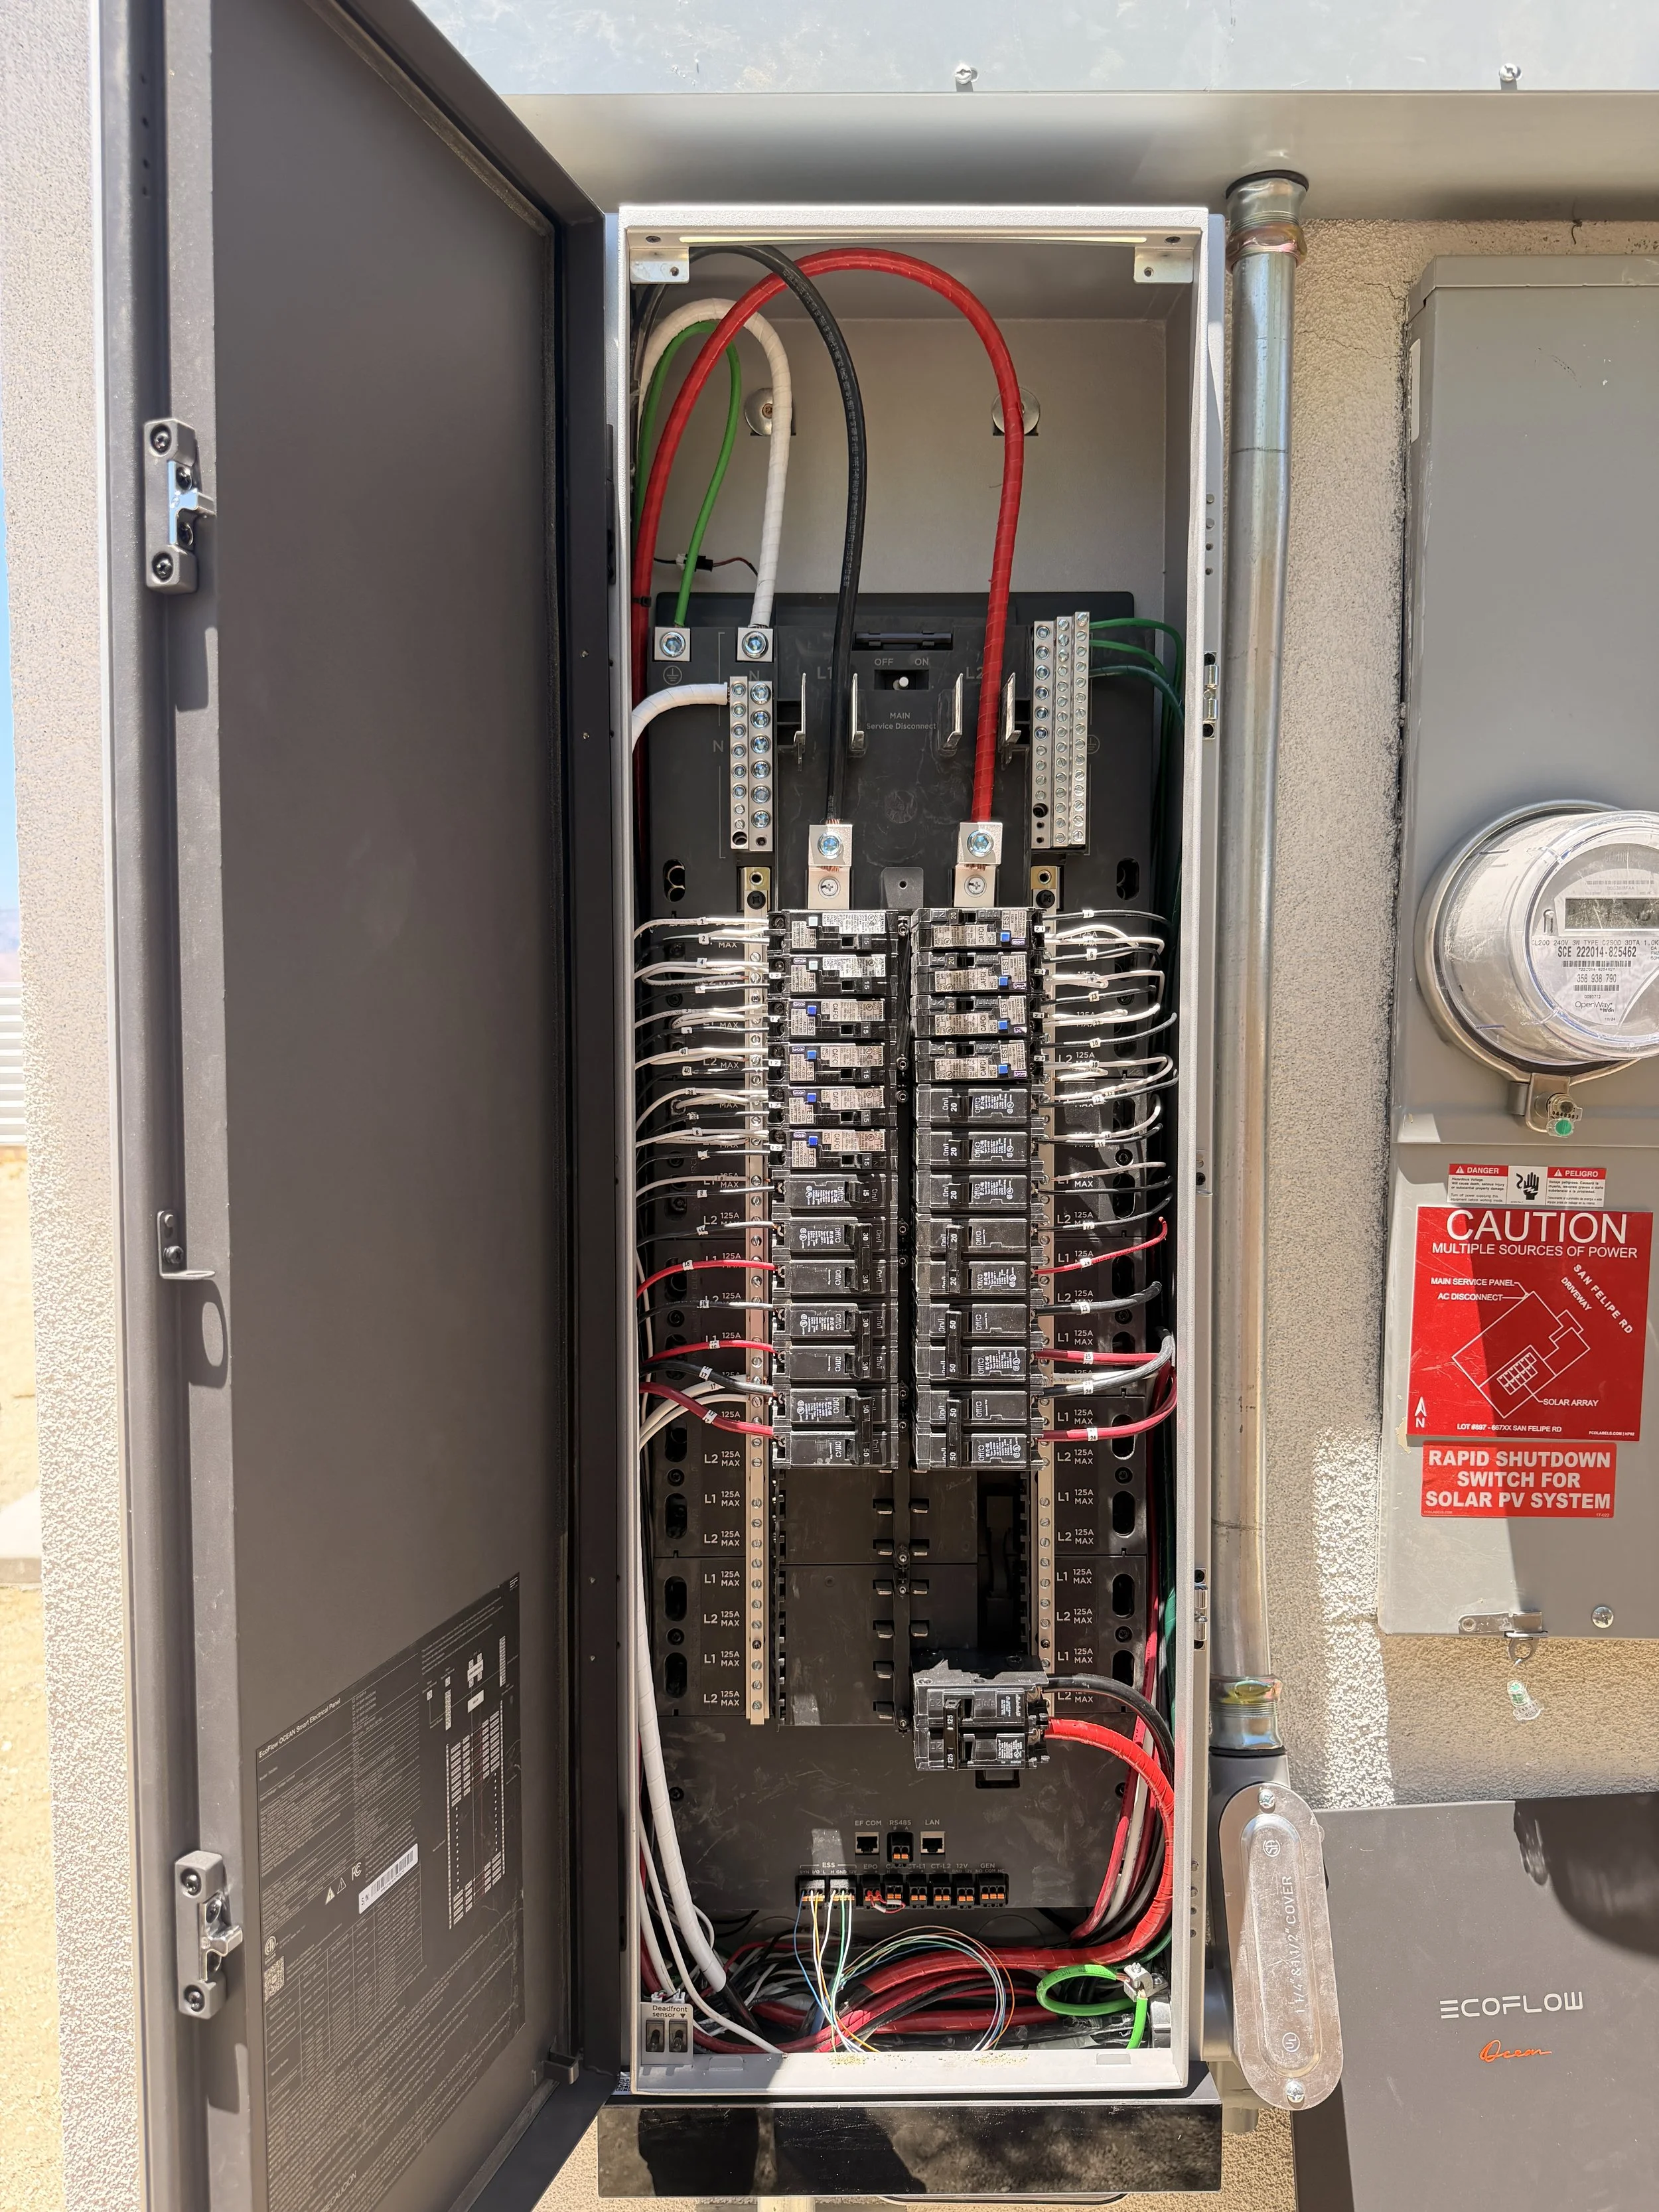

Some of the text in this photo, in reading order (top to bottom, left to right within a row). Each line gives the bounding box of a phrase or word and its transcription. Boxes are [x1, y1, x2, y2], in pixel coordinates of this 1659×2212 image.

[749, 670, 760, 682] N
[817, 668, 832, 680] L1
[966, 668, 983, 680] L2
[713, 741, 723, 752] N
[1557, 946, 1636, 957] SCE 222014-825462
[1577, 974, 1617, 983] 358 938 790
[864, 981, 869, 990] 15
[1575, 1001, 1611, 1009] OpenWay
[703, 1058, 717, 1067] L2
[951, 1103, 958, 1112] 20
[703, 1216, 718, 1225] L2
[1446, 1209, 1626, 1244] CAUTION
[863, 1232, 869, 1241] 30
[1432, 1242, 1638, 1258] MULTIPLE SOURCES OF POWER
[1058, 1253, 1070, 1262] L1
[1561, 1277, 1593, 1313] DRIVEWAY
[1573, 1264, 1633, 1334] SAN FELIPE RD
[950, 1319, 956, 1330] 50
[1058, 1333, 1070, 1342] L1
[863, 1404, 869, 1414] 50
[1415, 1418, 1425, 1428] N
[705, 1455, 718, 1464] L2
[1429, 1449, 1611, 1468] RAPID SHUTDOWN
[1457, 1471, 1581, 1488] SWITCH FOR
[1058, 1492, 1070, 1501] L1
[1425, 1491, 1611, 1509] SOLAR PV SYSTEM
[703, 1694, 718, 1703] L2
[259, 1698, 341, 1759] EcoFlow OCEAN Smart Electrical Panel
[1282, 1876, 1297, 1924] COVER
[1439, 1991, 1583, 2019] ECOFLOW
[1479, 2039, 1552, 2063] Ocean
